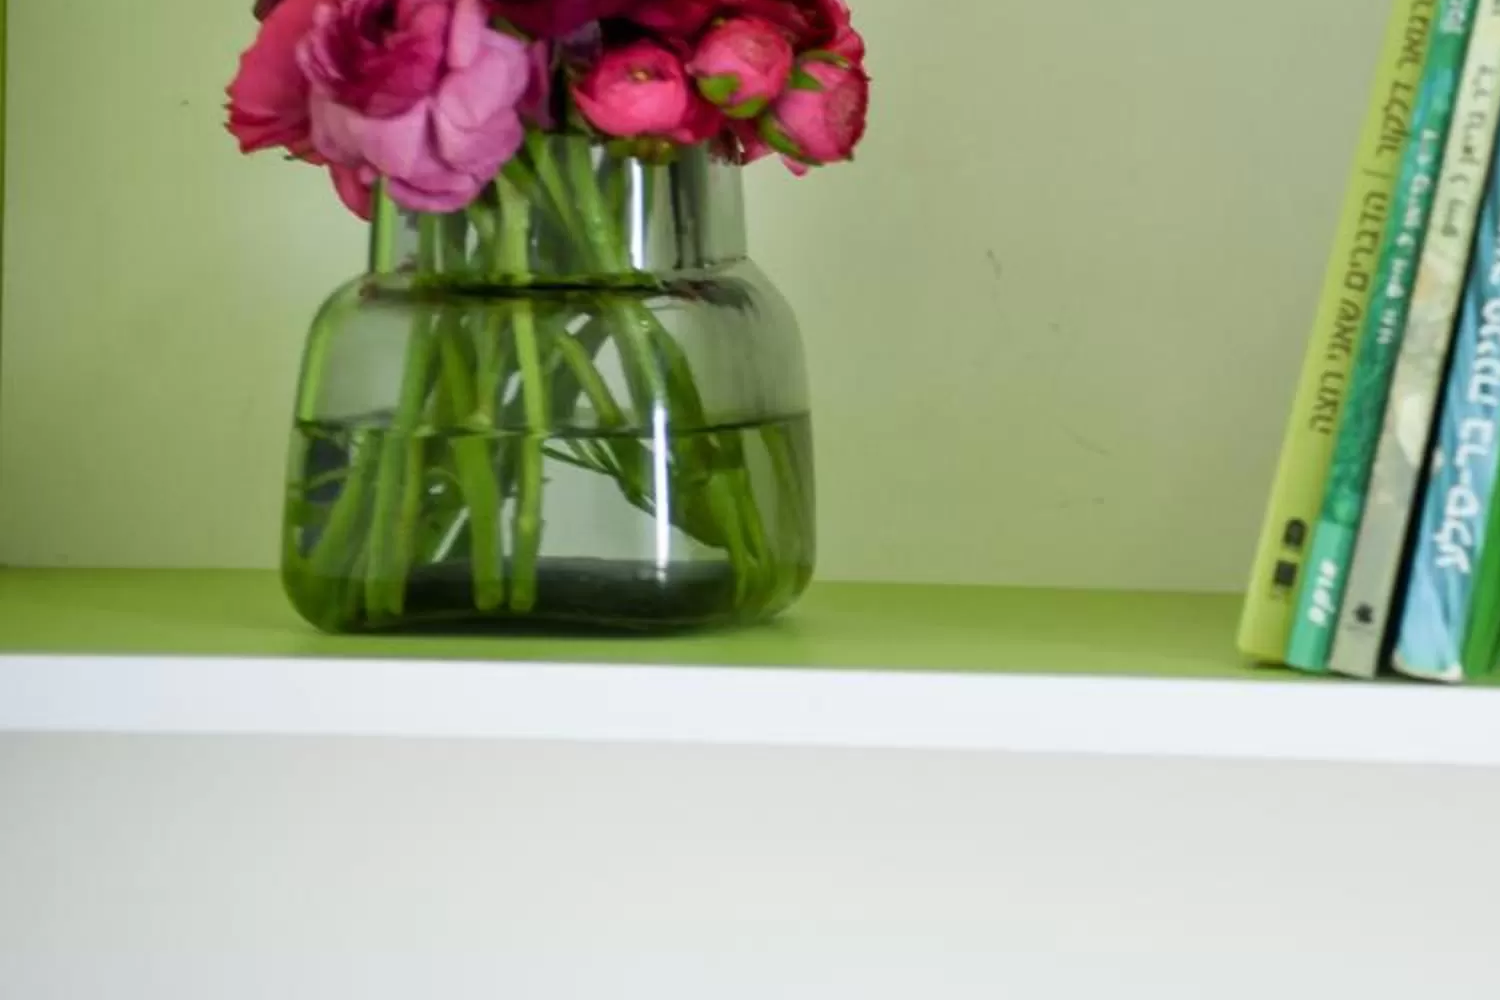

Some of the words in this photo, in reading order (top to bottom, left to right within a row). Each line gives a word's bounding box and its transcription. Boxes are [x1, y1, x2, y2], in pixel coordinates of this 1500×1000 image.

[1345, 190, 1388, 292] הדברים
[1327, 298, 1362, 360] שאני
[1308, 369, 1345, 435] רוצה
[1434, 417, 1494, 573] בר-סלע
